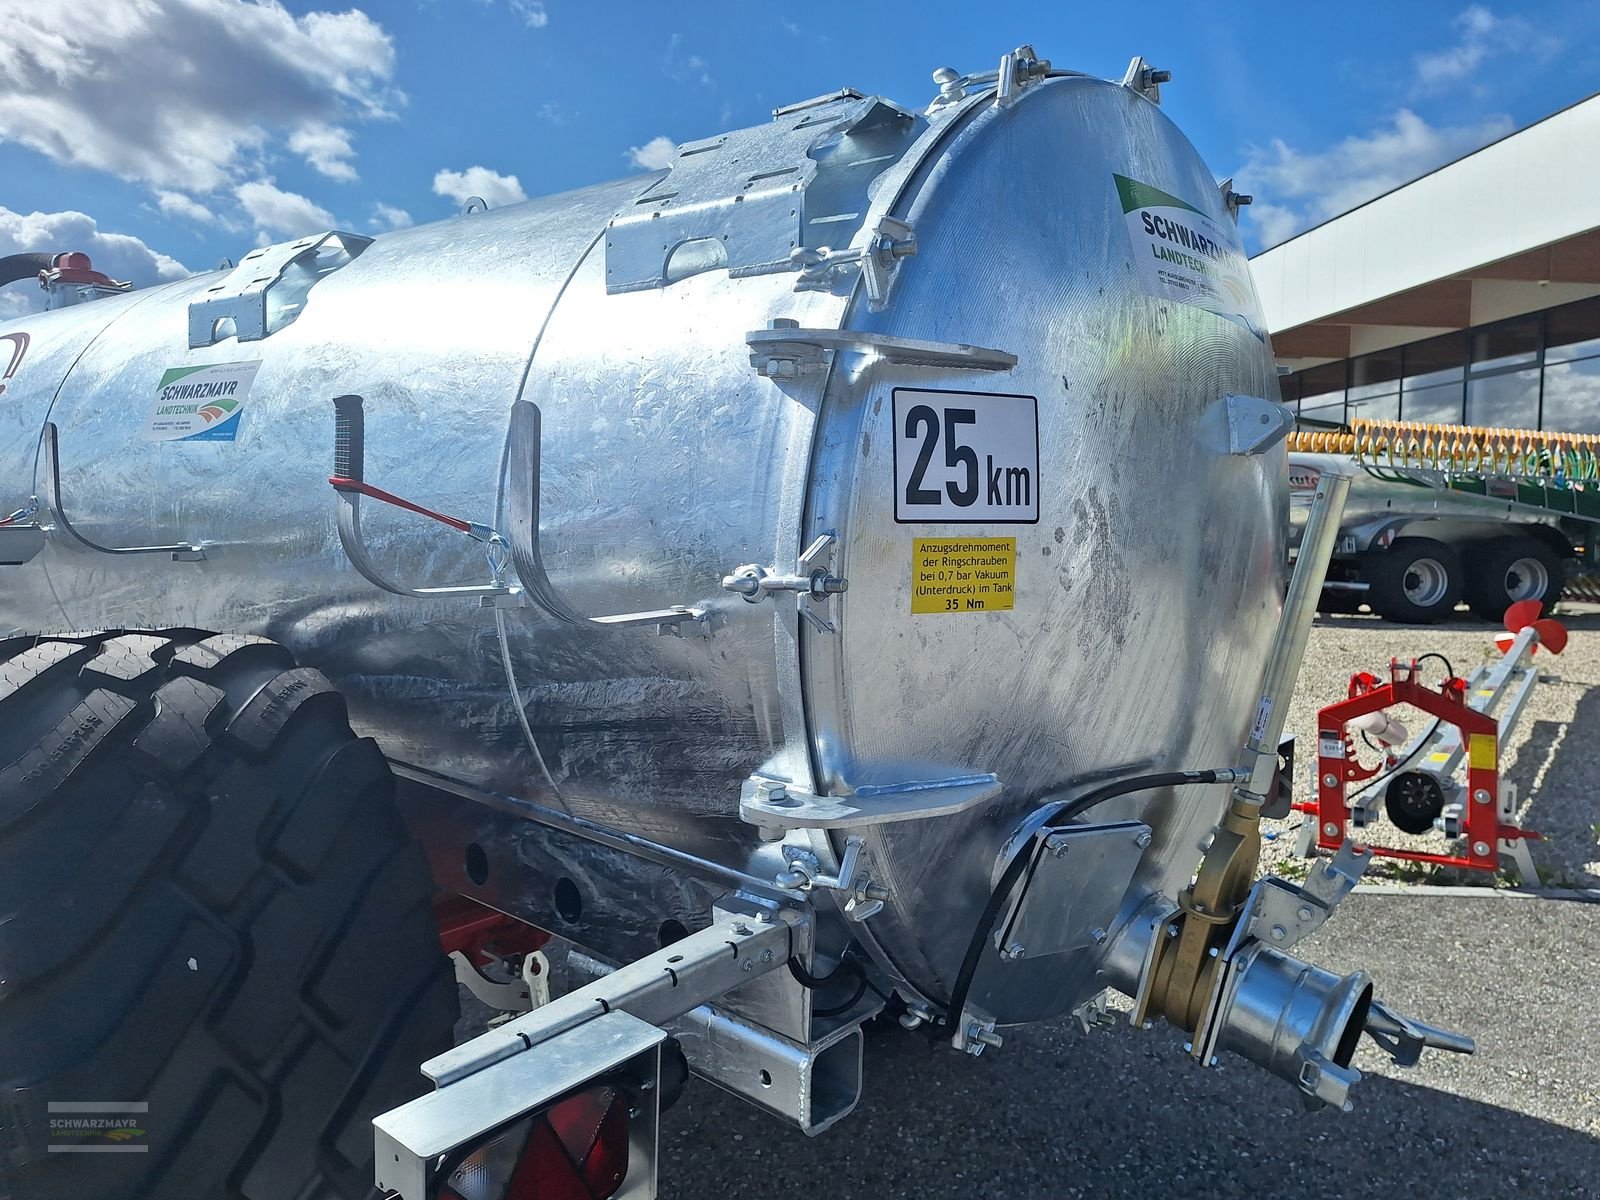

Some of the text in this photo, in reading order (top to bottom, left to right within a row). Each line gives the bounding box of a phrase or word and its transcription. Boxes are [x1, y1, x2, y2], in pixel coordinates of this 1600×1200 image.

[1141, 210, 1240, 272] SCHWARZM
[1151, 243, 1221, 281] LANDTECH
[160, 381, 238, 400] SCHWARZMAYR
[156, 404, 200, 416] LANDTECHNIK
[905, 404, 1030, 507] 25 km
[920, 543, 1010, 555] Anzugsdrehmoment
[922, 556, 1008, 568] der Ringschrauben
[920, 569, 1009, 582] bei 0,7 bar Vakuum
[915, 583, 1012, 597] (Unterdruck) im Tank
[945, 599, 985, 611] 35 Nm
